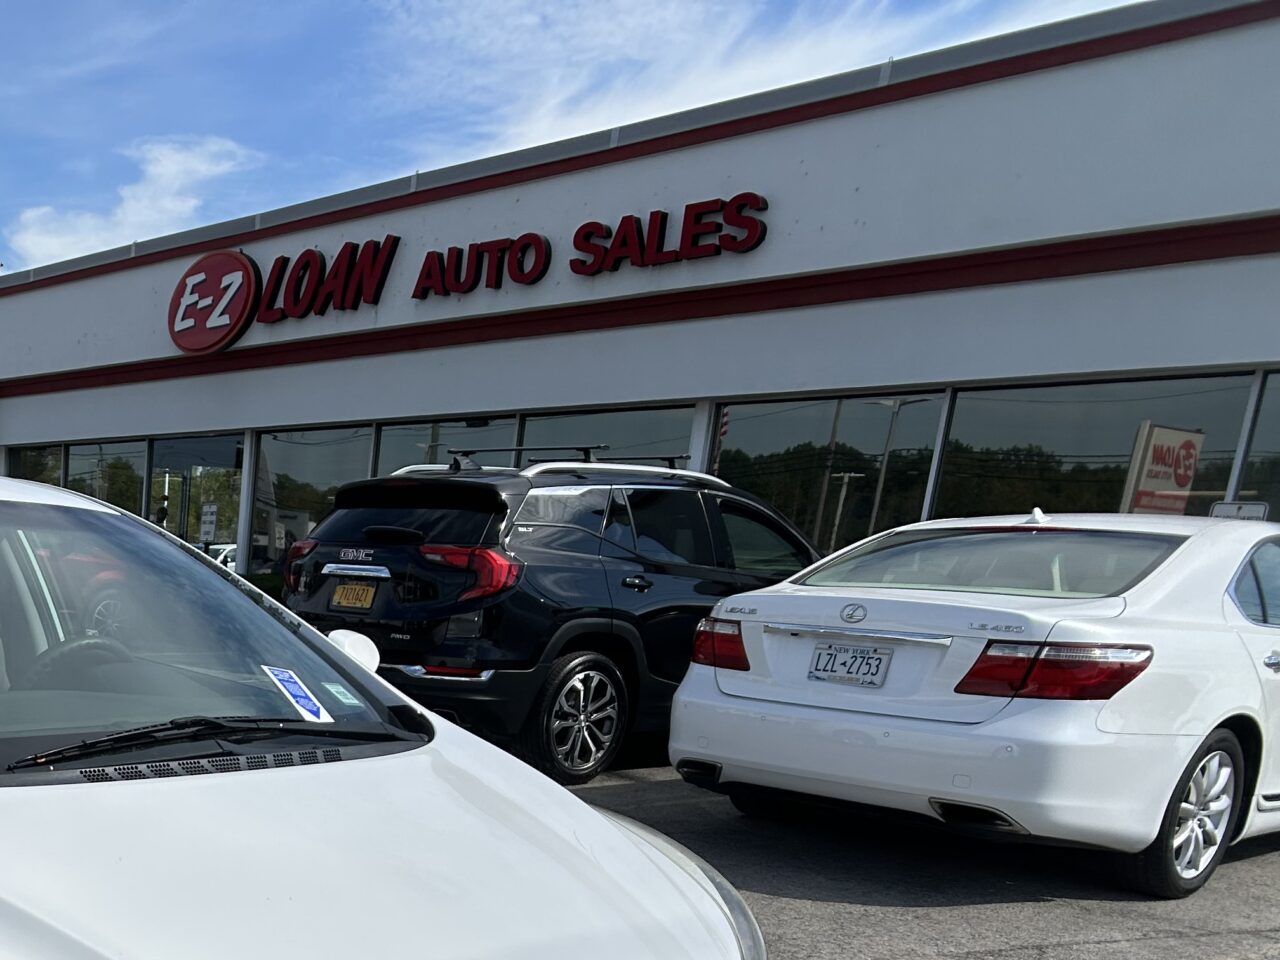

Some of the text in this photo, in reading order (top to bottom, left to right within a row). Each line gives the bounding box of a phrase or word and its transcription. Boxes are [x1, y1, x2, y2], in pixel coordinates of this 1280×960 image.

[173, 192, 769, 334] E-Z LOAN AUTO SALES
[340, 548, 374, 560] GMC
[725, 606, 758, 615] LEXUS
[833, 646, 871, 656] NEW YORK
